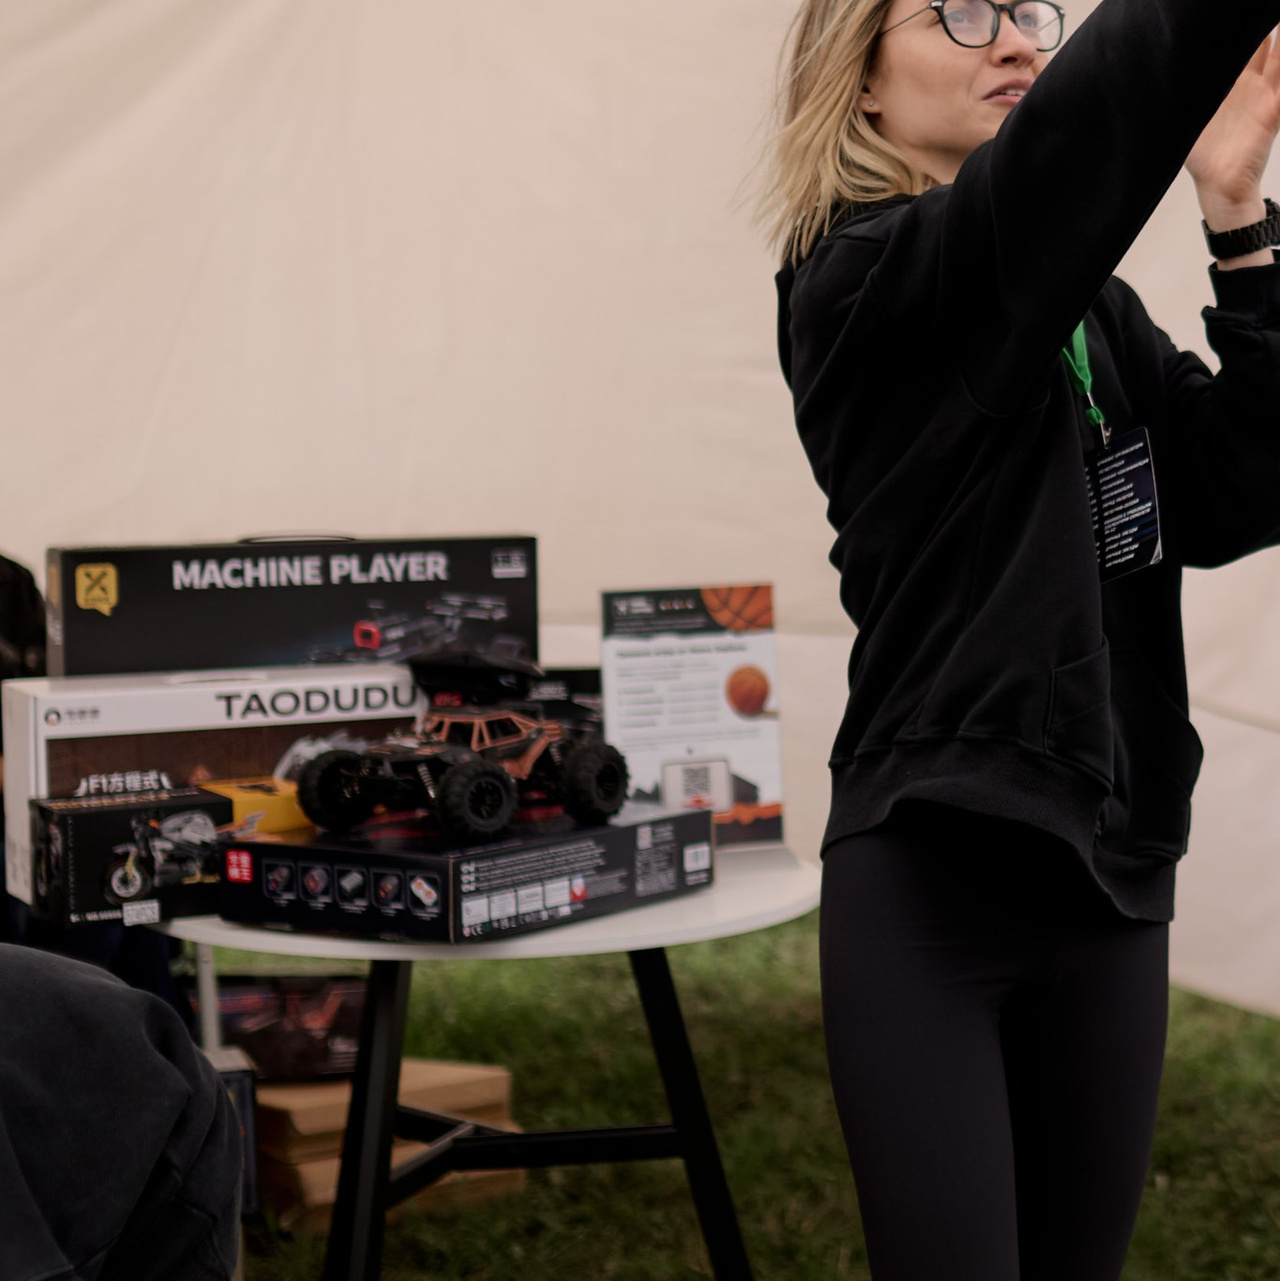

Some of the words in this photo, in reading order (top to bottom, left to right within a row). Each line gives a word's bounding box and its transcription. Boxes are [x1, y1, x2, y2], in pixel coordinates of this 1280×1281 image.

[172, 557, 323, 590] MACHINE
[330, 551, 448, 584] PLAYER
[215, 685, 418, 720] TAODUDU
